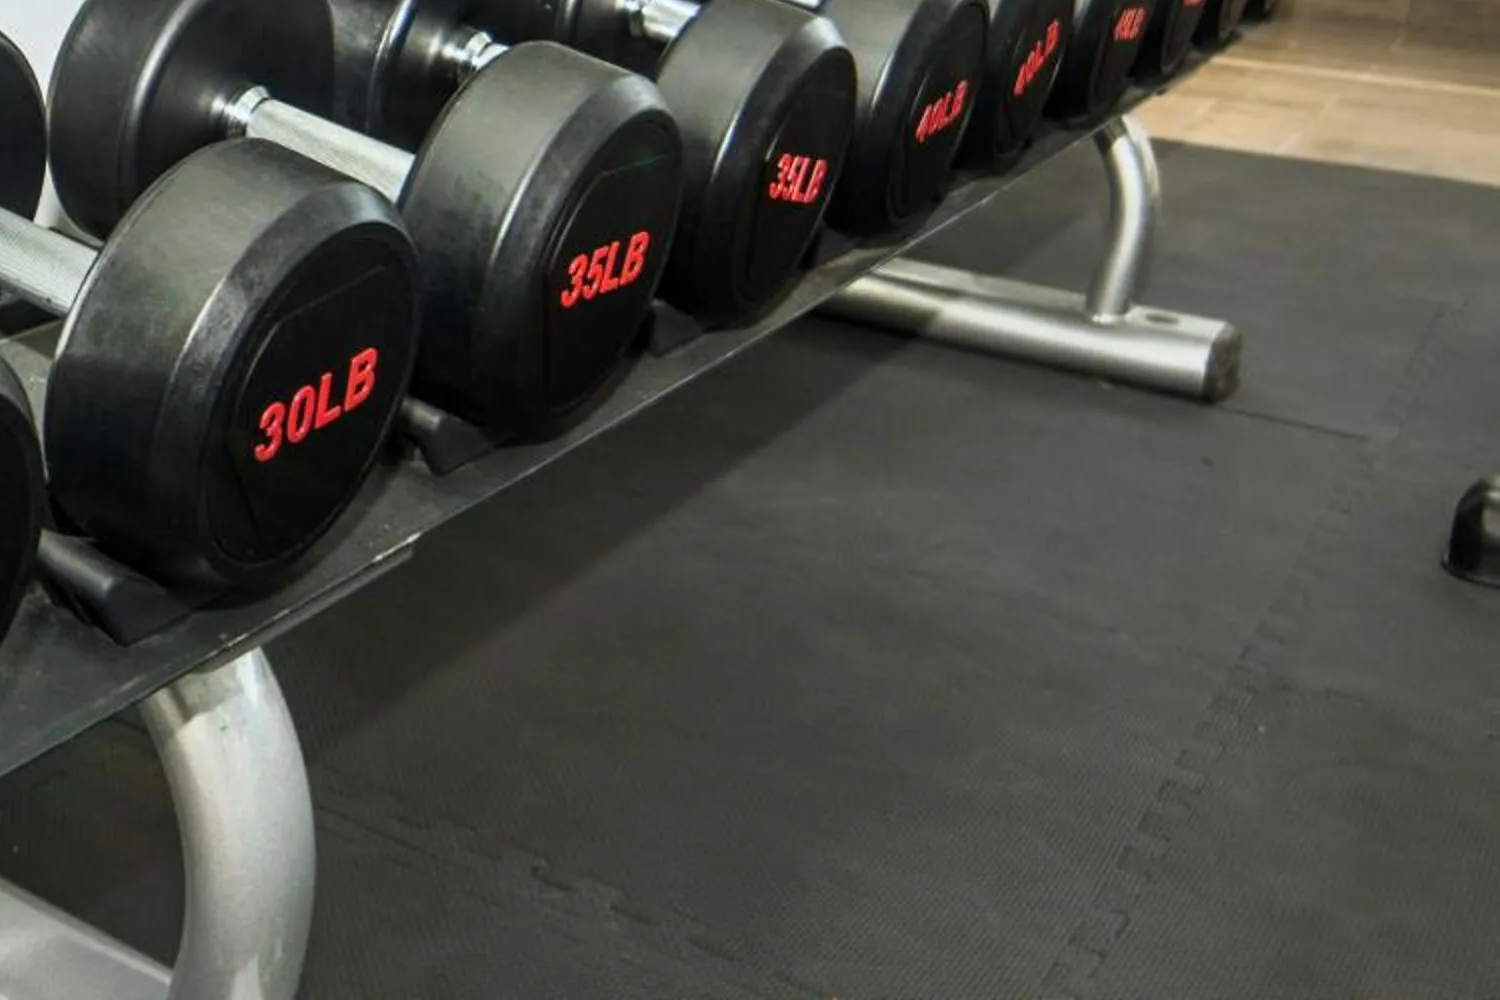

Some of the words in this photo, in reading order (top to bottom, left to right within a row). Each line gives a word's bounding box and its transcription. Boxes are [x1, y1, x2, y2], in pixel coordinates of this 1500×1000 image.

[766, 152, 828, 205] 35LB
[558, 229, 651, 310] 35LB
[253, 346, 379, 463] 30LB
